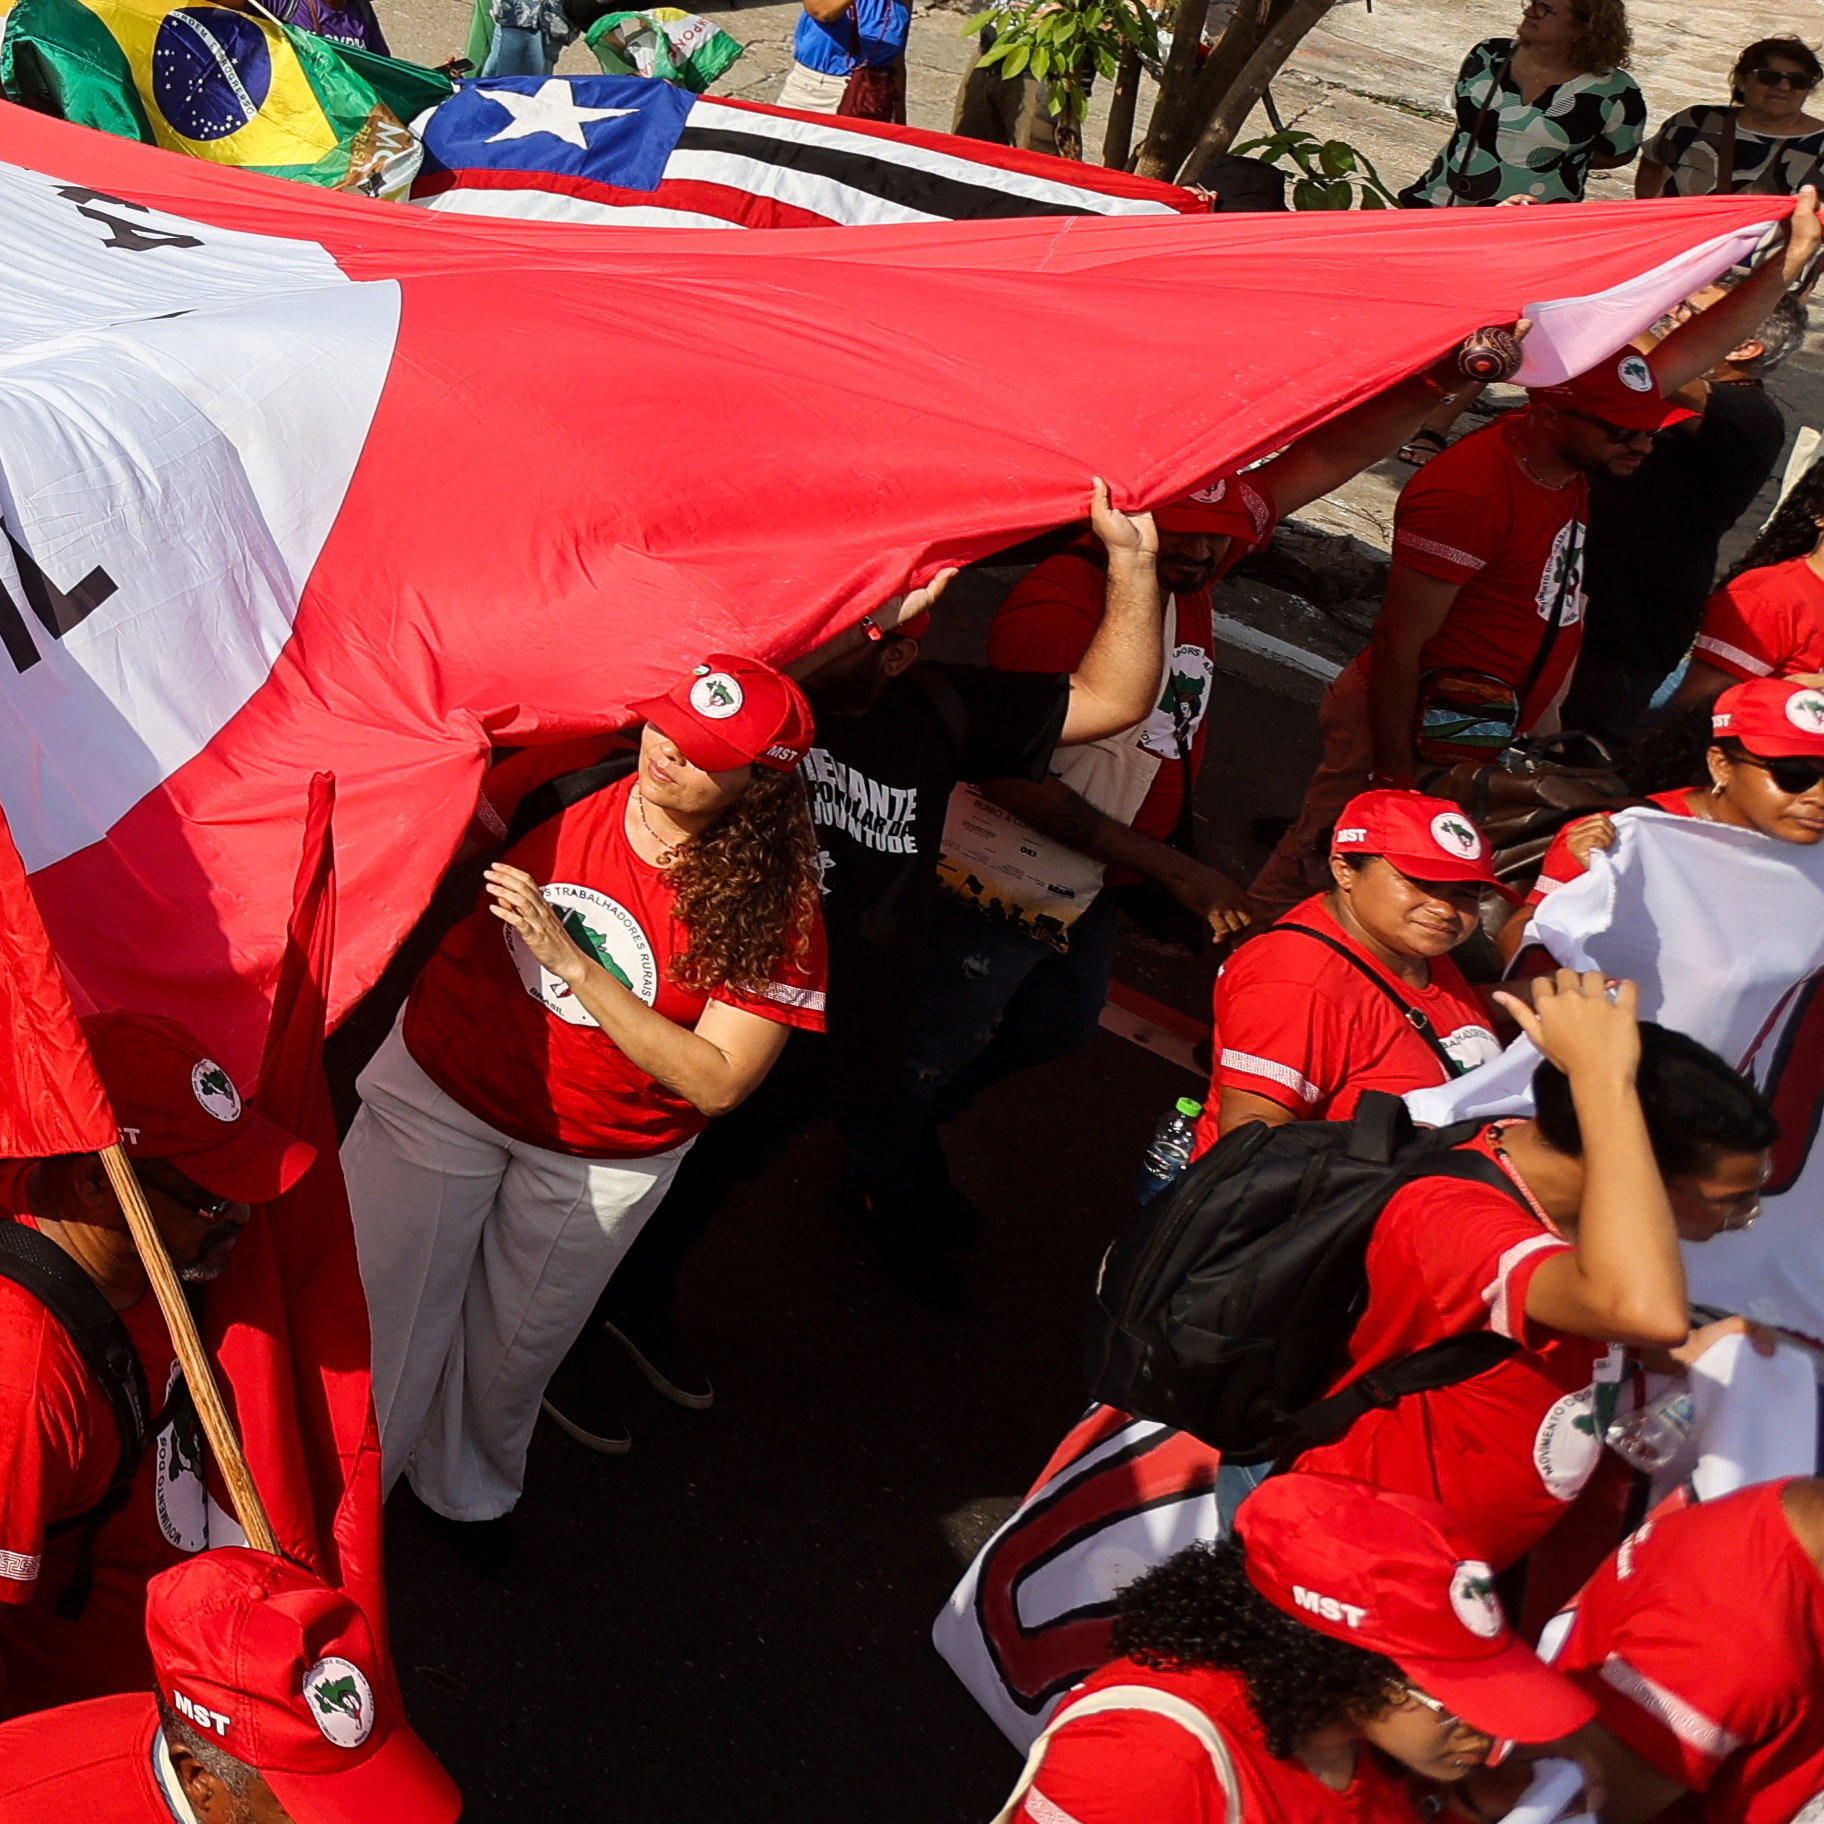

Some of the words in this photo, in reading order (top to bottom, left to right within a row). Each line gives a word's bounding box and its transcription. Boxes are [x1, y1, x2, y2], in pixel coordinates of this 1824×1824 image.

[174, 11, 208, 39] ORDEM
[352, 123, 372, 174] BRASIL
[766, 744, 800, 765] MST
[1336, 828, 1368, 843] MST
[554, 886, 646, 954] TRABALHADORES
[638, 953, 653, 998] RURAIS
[157, 1434, 168, 1471] DOS
[1536, 1406, 1565, 1476] MOVIMENTO
[155, 1483, 182, 1545] MOVIMENTO
[1292, 1584, 1365, 1628] MST
[173, 1689, 230, 1736] MST
